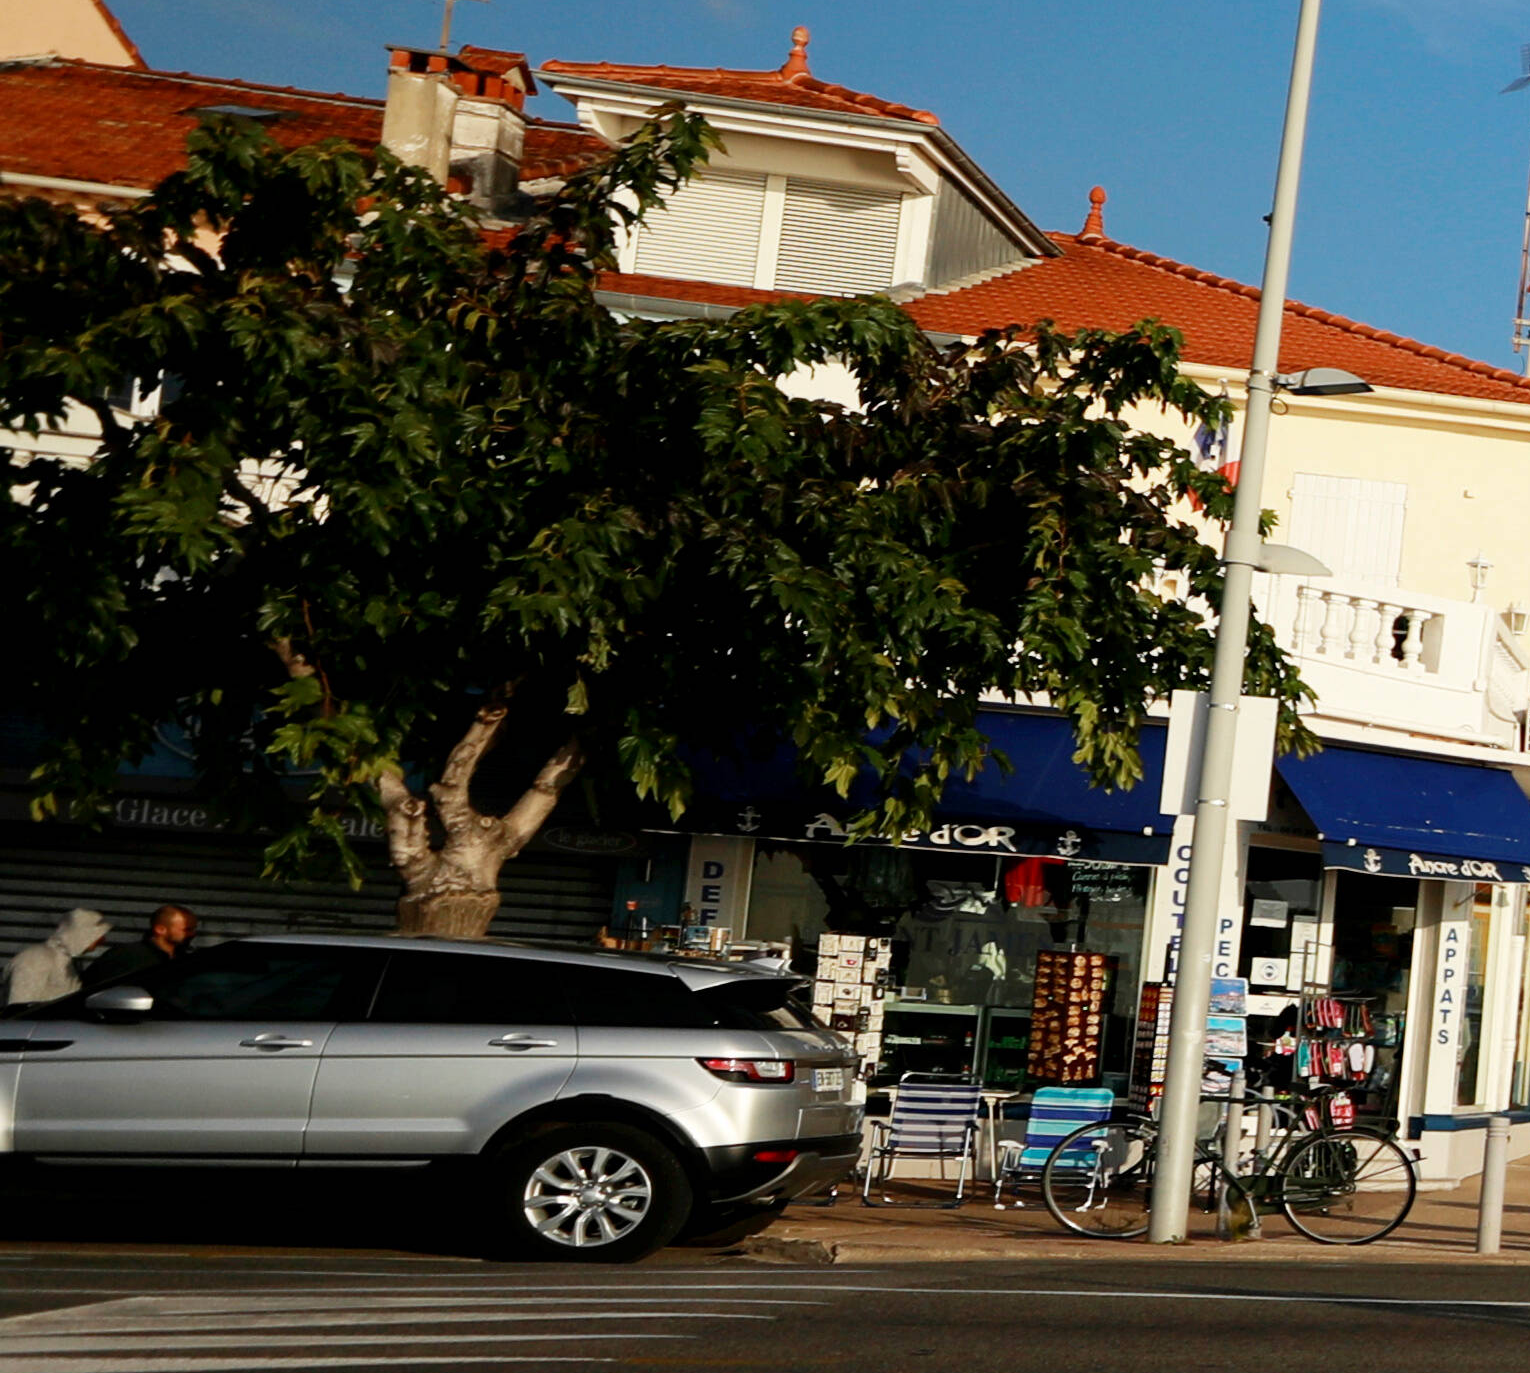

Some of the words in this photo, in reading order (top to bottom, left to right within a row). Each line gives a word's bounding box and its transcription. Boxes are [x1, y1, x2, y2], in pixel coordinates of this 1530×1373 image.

[115, 797, 208, 829] Glace
[928, 823, 1018, 853] d'OR
[1407, 852, 1459, 876] Ancre
[1460, 859, 1503, 882] d'OR
[1436, 927, 1459, 1045] APPATS
